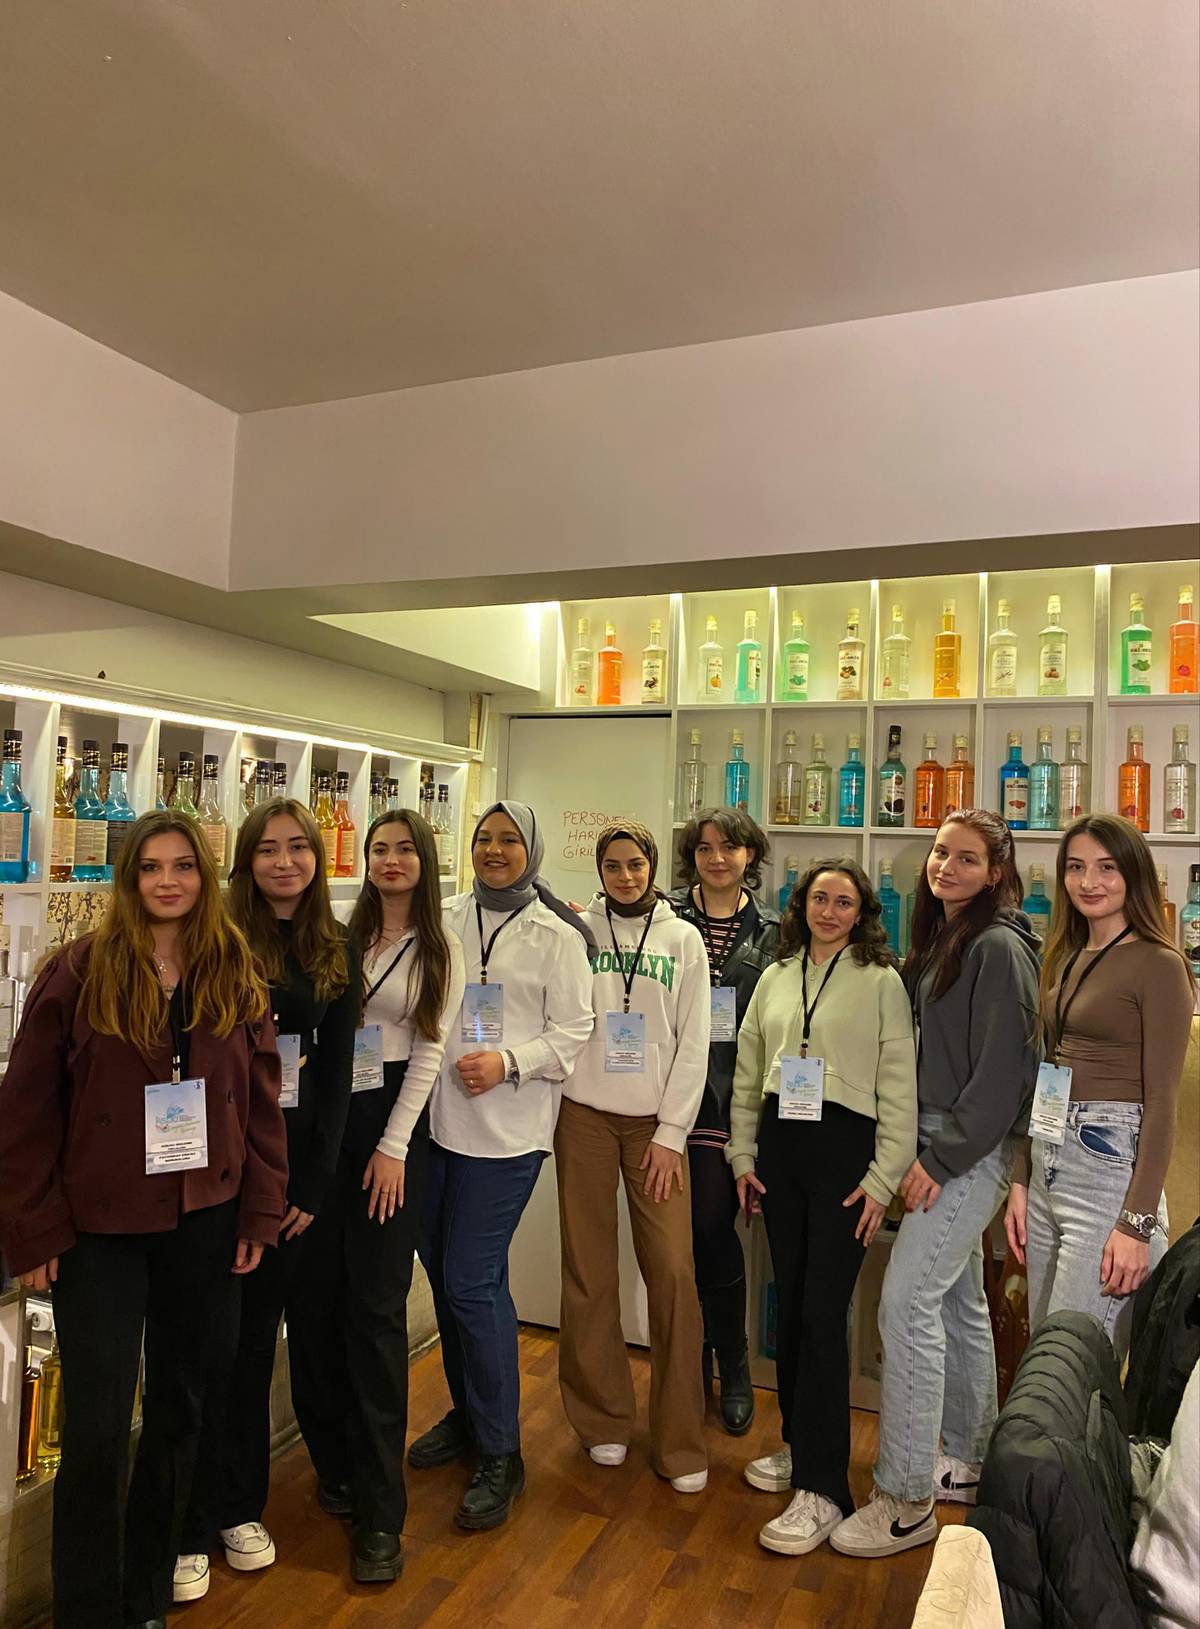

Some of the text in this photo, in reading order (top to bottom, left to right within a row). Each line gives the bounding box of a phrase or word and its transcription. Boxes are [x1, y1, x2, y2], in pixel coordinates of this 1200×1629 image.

[563, 811, 625, 827] PERSONE
[568, 829, 599, 842] HARI
[590, 951, 676, 994] ROOKLYN
